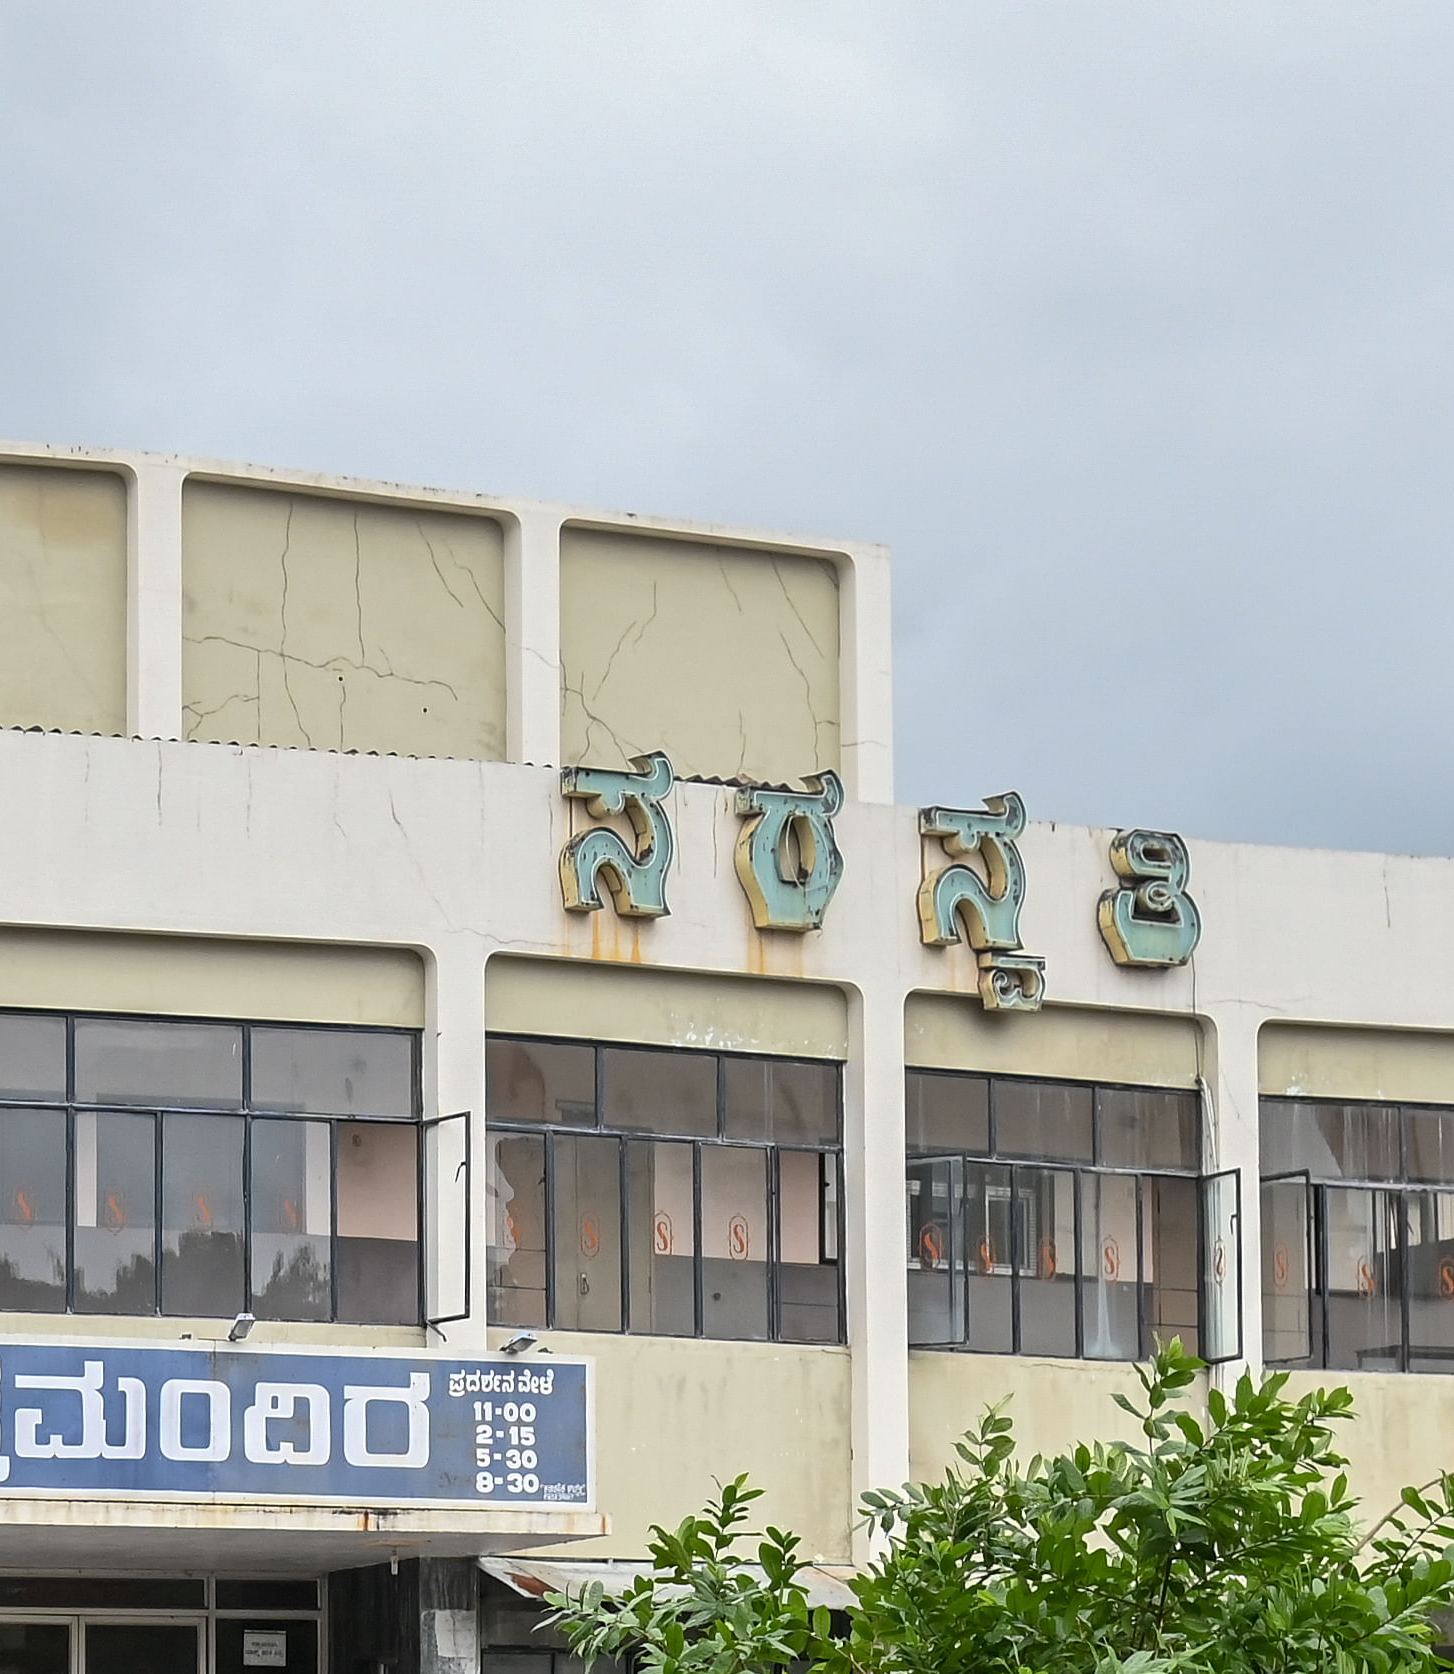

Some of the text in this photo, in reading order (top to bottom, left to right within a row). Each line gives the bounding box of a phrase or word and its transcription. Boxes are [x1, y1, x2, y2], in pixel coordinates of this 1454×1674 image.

[559, 750, 1202, 1012] ಸರಸ್ವತಿ
[448, 1368, 554, 1397] ಪ್ರದರ್ಶನ ವೇಳೆ
[473, 1401, 536, 1422] 11-00
[475, 1425, 536, 1446] 2-15
[476, 1448, 538, 1469] 5-30
[475, 1471, 540, 1493] 8-30
